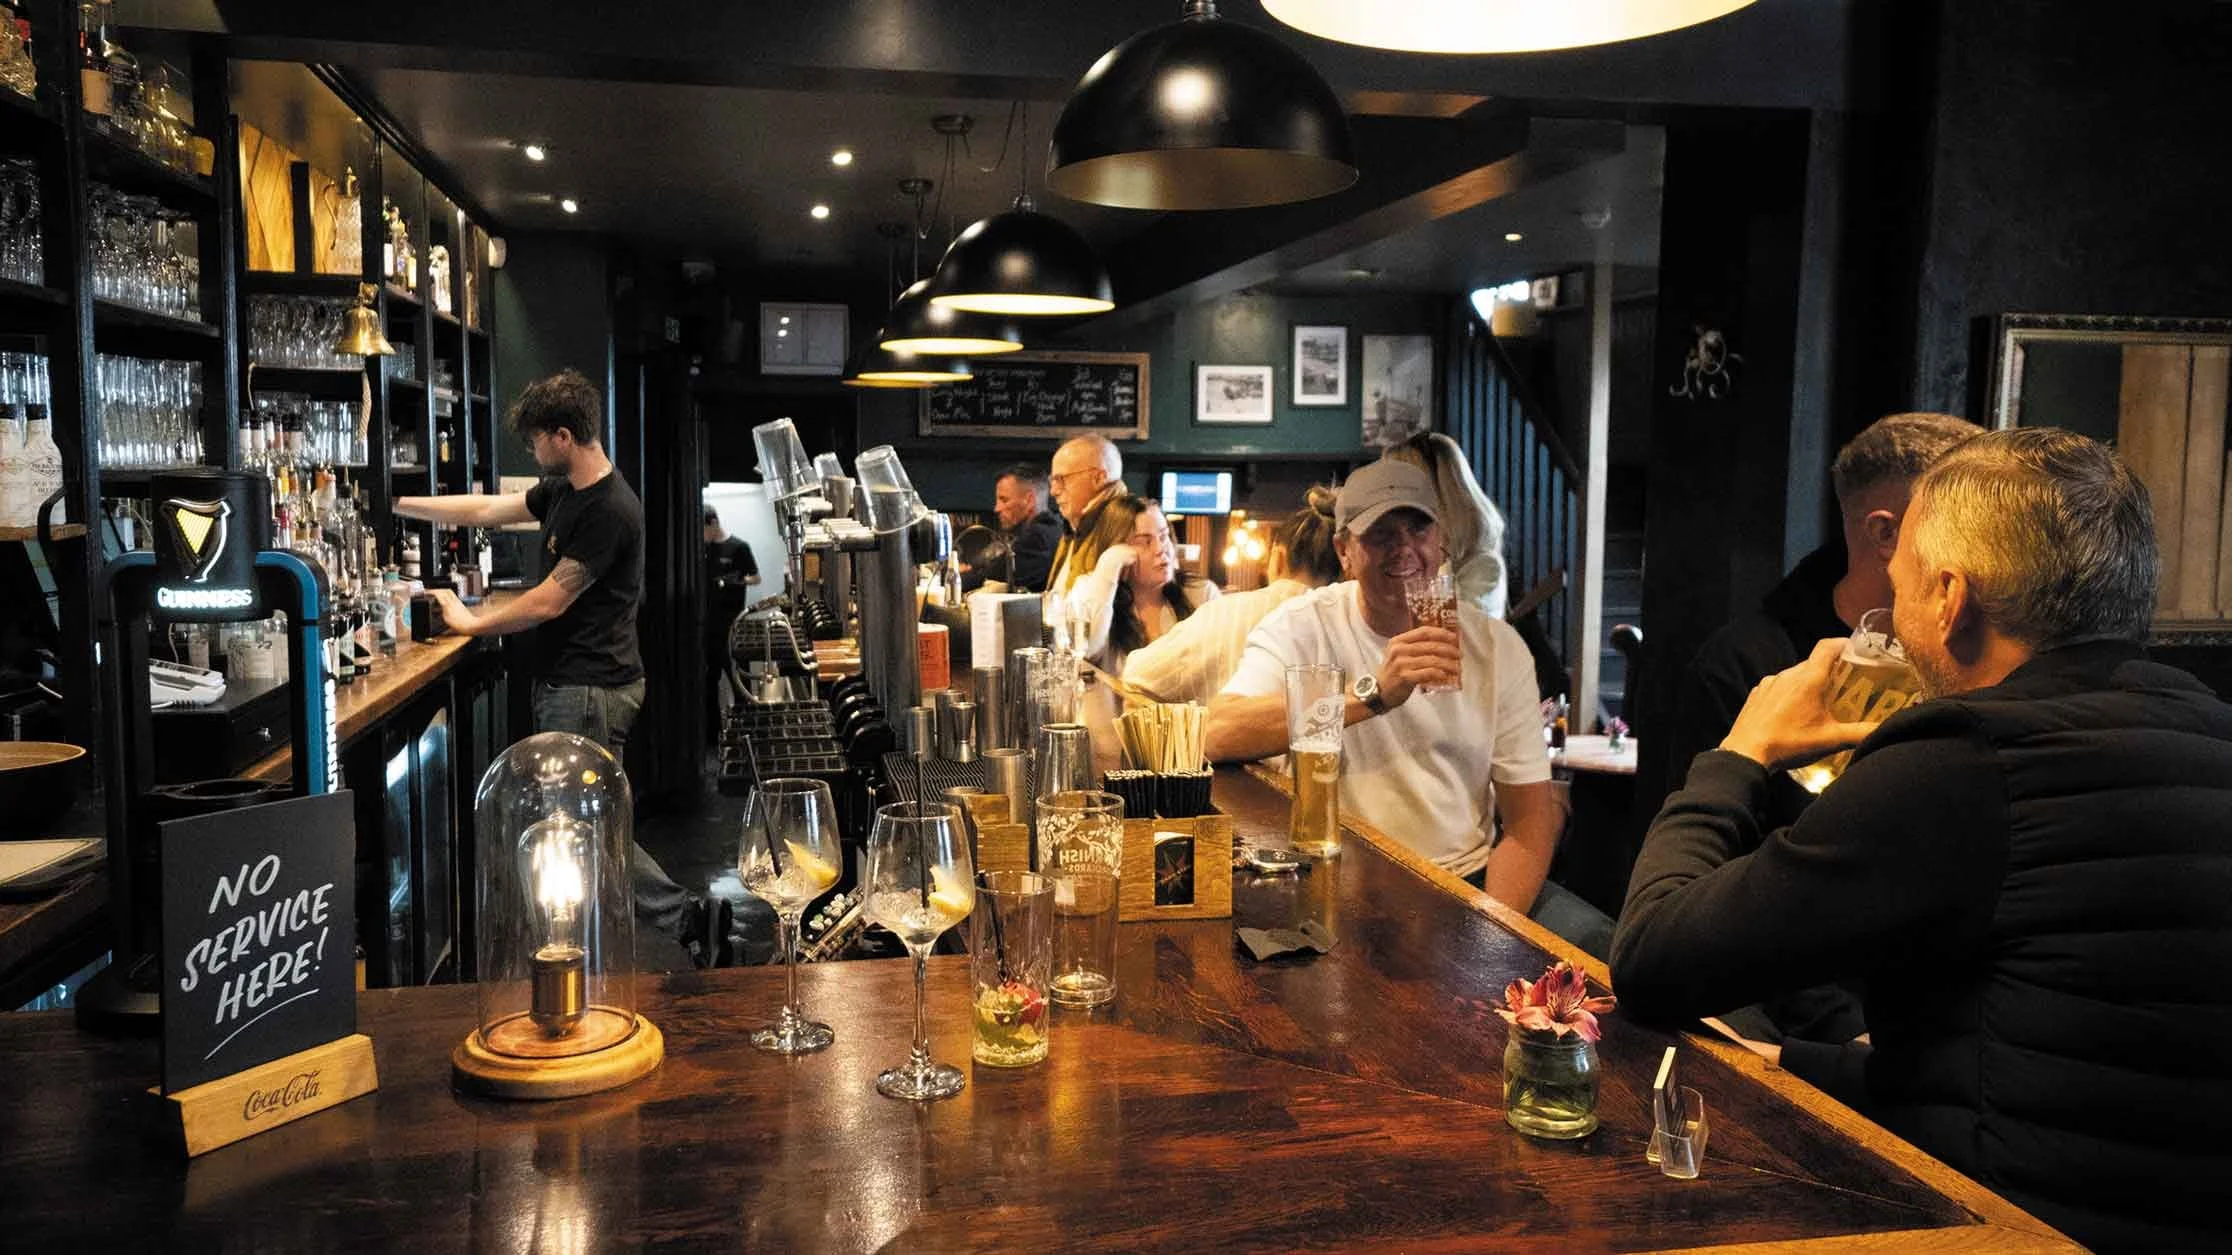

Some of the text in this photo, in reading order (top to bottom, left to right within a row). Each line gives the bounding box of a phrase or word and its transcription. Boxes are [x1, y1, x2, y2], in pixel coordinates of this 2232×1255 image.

[208, 854, 281, 914] NO
[180, 883, 334, 992] SERVICE
[215, 926, 329, 1025] HERE!
